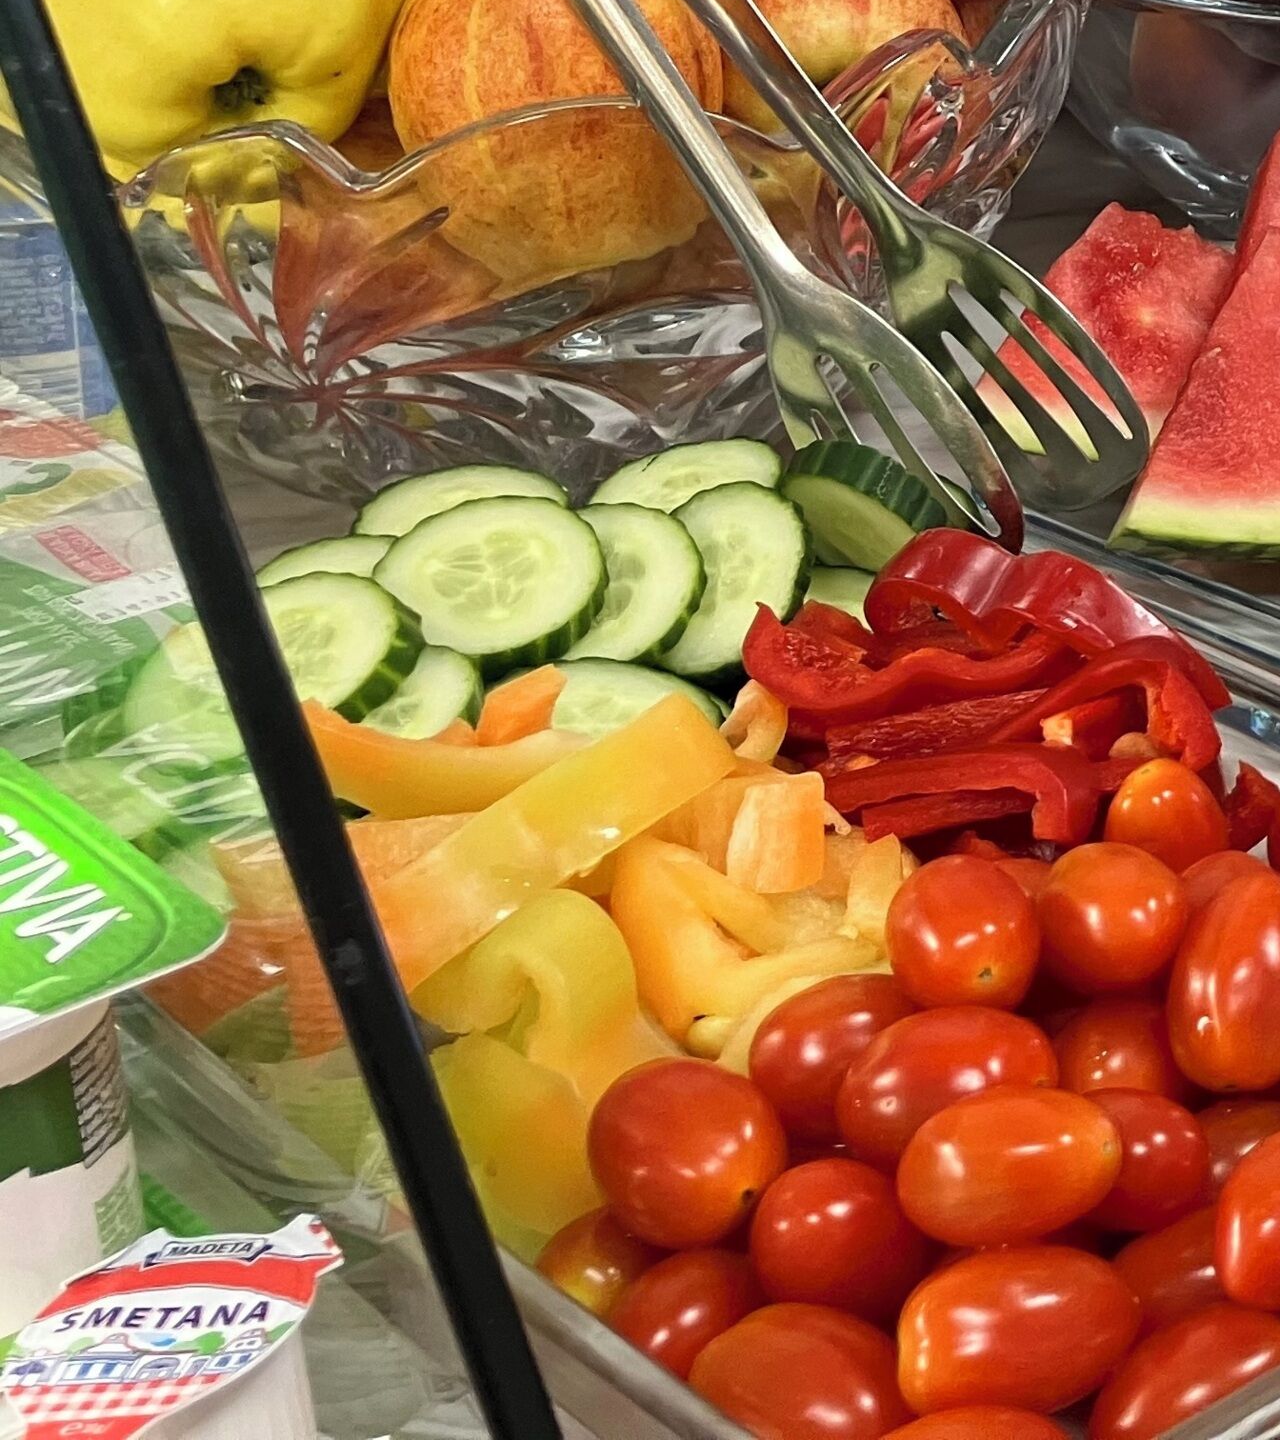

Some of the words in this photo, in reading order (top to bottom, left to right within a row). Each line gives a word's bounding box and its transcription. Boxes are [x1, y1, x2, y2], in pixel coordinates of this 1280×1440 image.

[0, 814, 125, 965] TIVIA
[169, 1241, 254, 1257] MADETA
[53, 1300, 271, 1334] SMETANA
